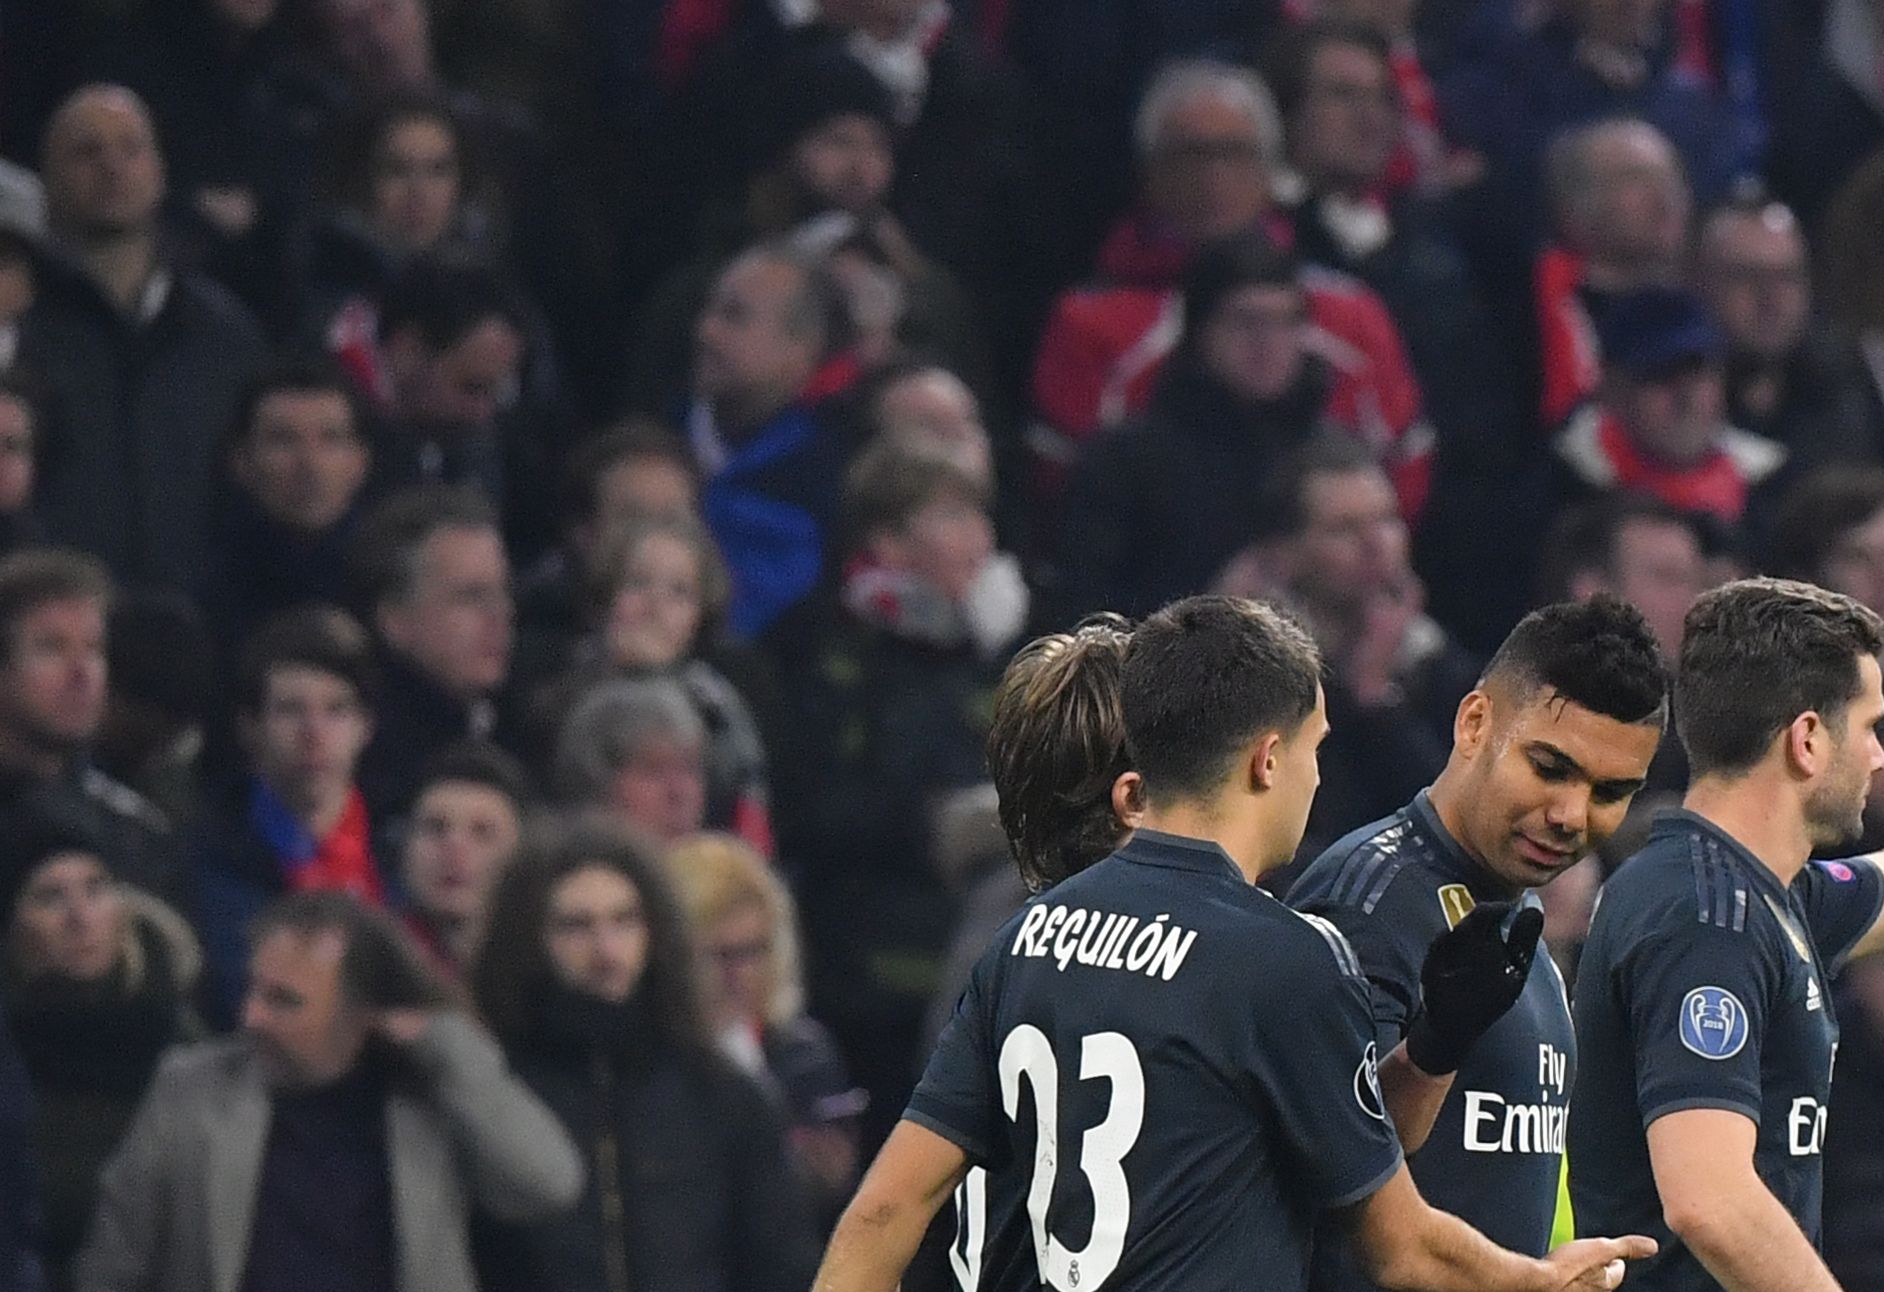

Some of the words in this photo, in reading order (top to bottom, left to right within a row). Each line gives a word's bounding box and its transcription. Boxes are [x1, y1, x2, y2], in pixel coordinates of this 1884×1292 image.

[1011, 903, 1198, 982] REGUILÓN
[1538, 1043, 1566, 1095] Fly
[1463, 1090, 1570, 1154] Emira
